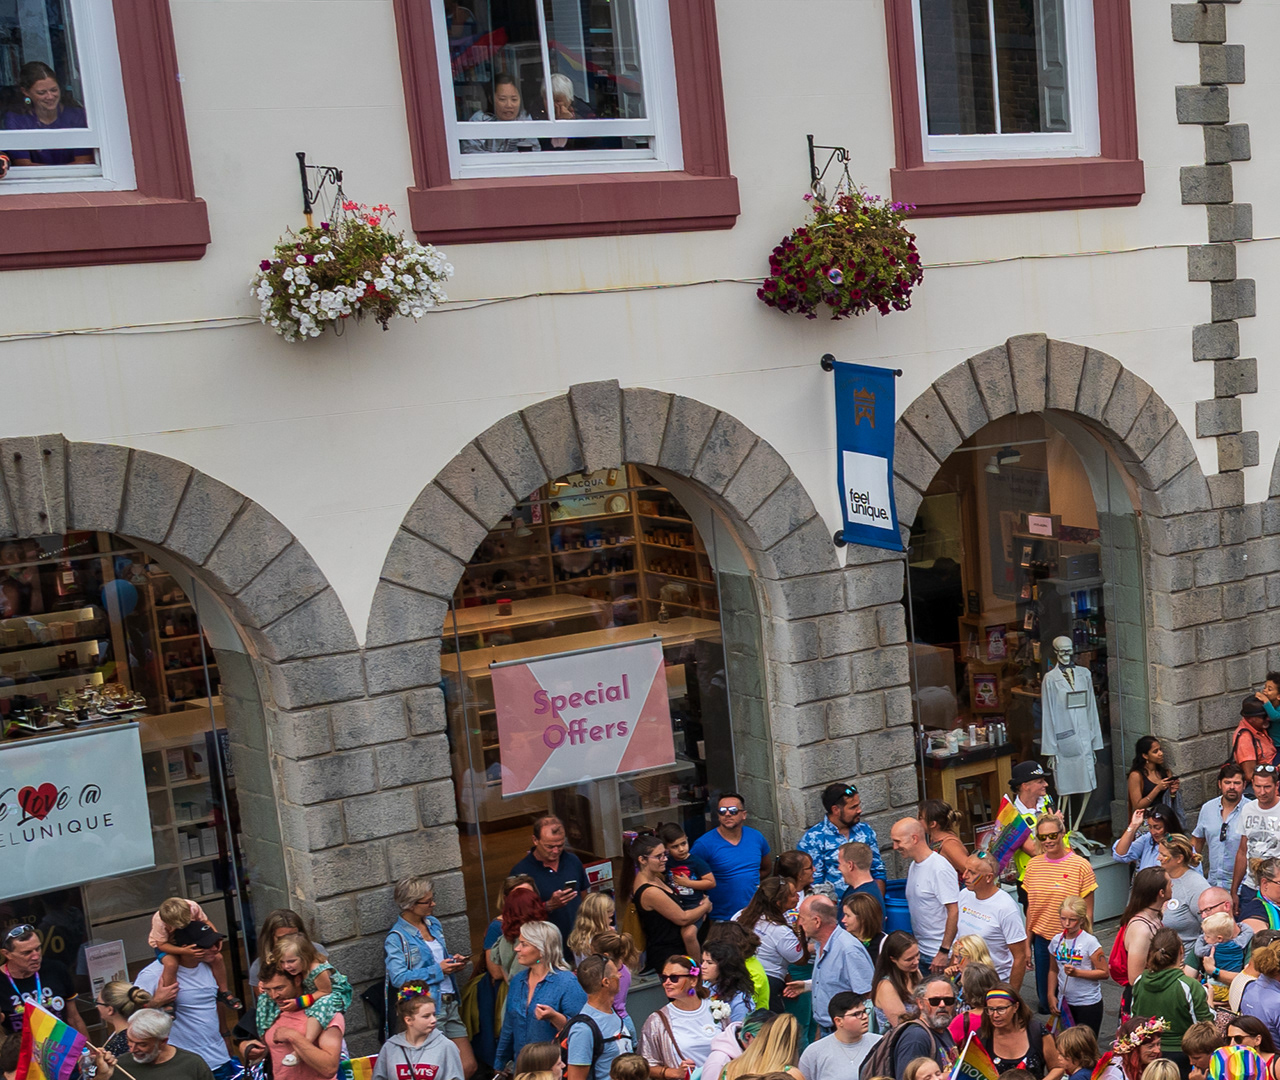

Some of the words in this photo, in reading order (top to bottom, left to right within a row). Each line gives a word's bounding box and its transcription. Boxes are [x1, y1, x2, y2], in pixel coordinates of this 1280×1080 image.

[572, 479, 604, 488] ACQUA
[849, 488, 870, 505] feel
[534, 674, 630, 718] Special
[543, 718, 629, 749] Offers
[994, 828, 1020, 858] PRIDE
[22, 914, 37, 924] TO
